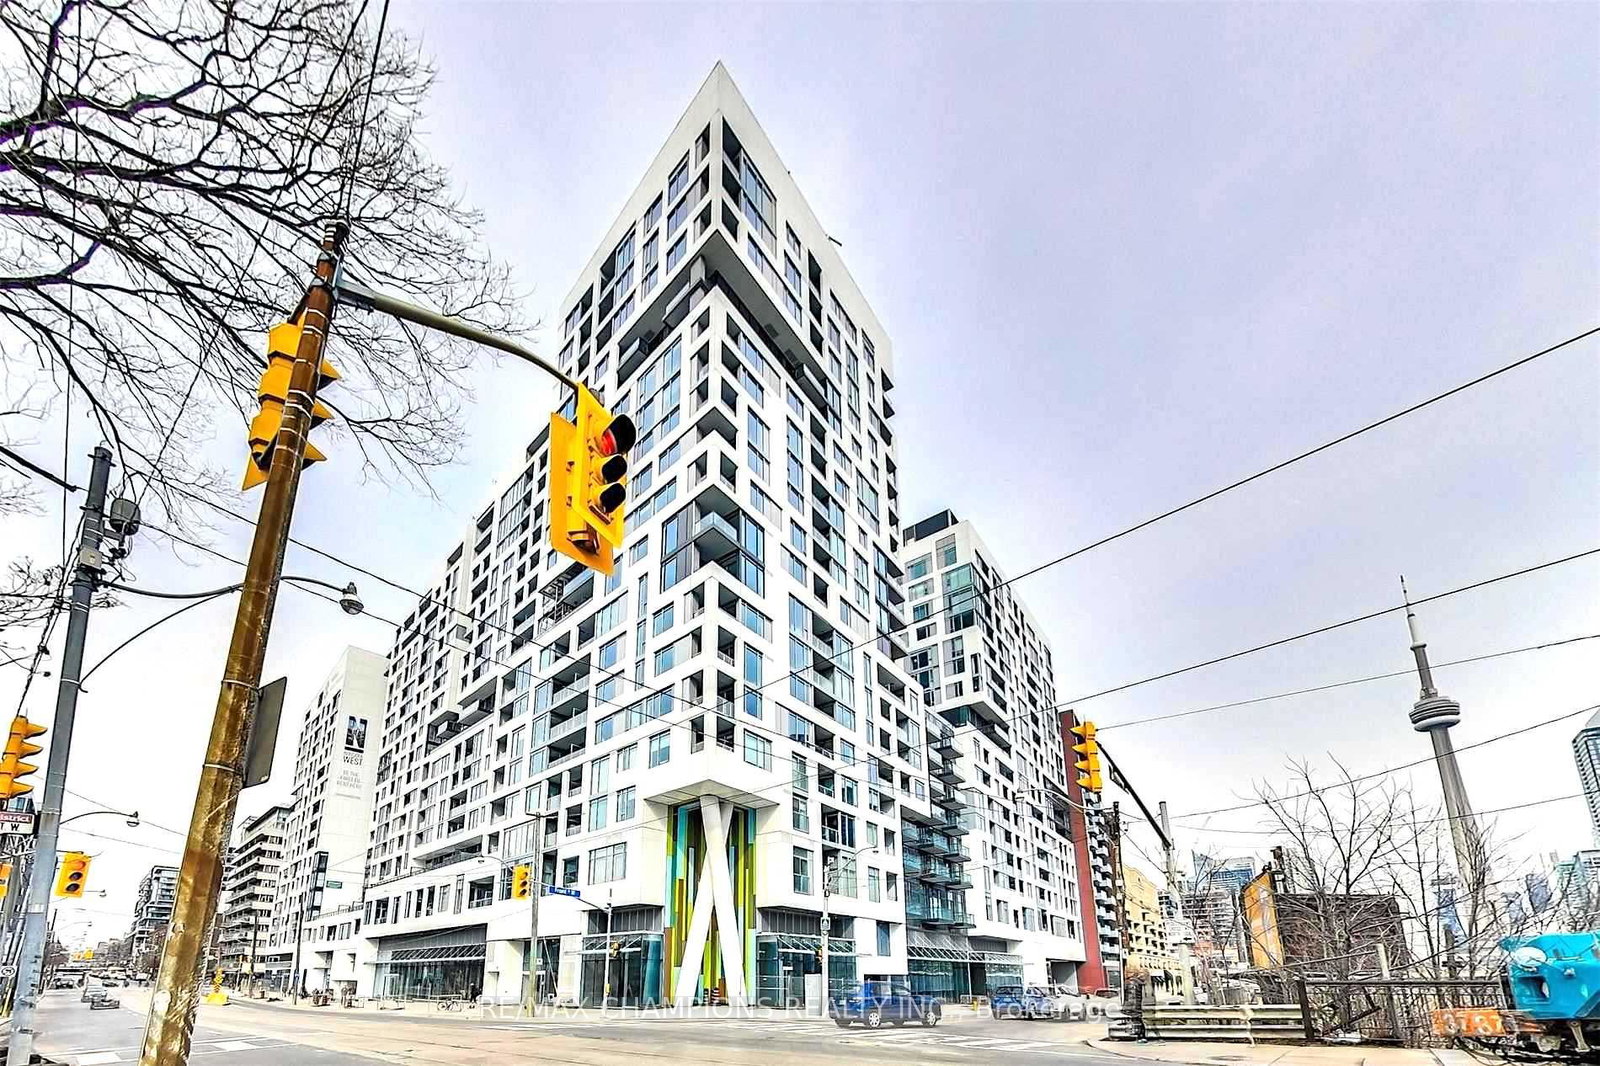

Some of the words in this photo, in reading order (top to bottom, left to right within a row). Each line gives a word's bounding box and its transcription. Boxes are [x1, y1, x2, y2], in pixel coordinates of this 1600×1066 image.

[343, 755, 364, 766] WEST
[0, 813, 31, 822] istrict
[11, 823, 20, 831] W
